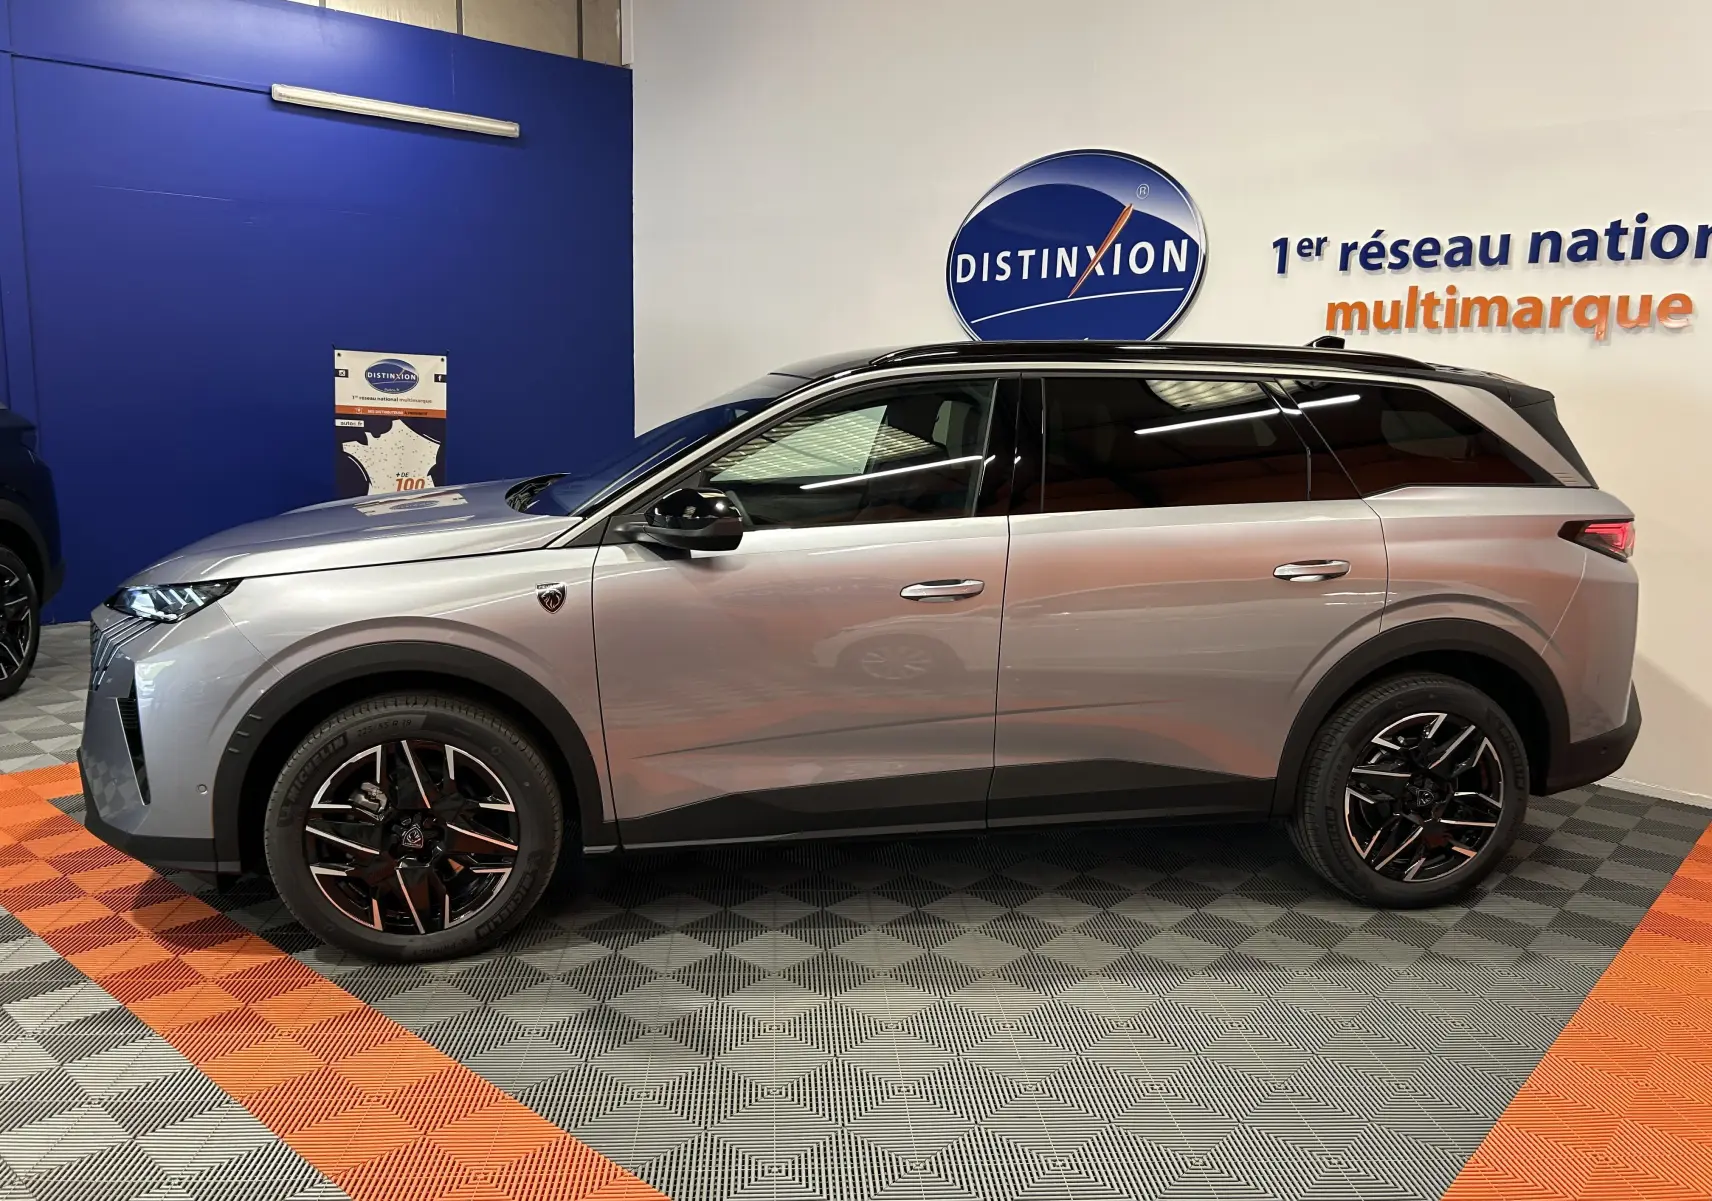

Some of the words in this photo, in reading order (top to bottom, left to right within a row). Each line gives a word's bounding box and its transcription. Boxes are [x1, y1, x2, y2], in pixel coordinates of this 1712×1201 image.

[956, 238, 1189, 283] DISTINXION
[1338, 229, 1511, 272] réseau
[1325, 285, 1693, 341] multimarque
[367, 371, 416, 381] DISTINXION
[395, 478, 425, 492] 100
[286, 734, 346, 804] MICHELIN
